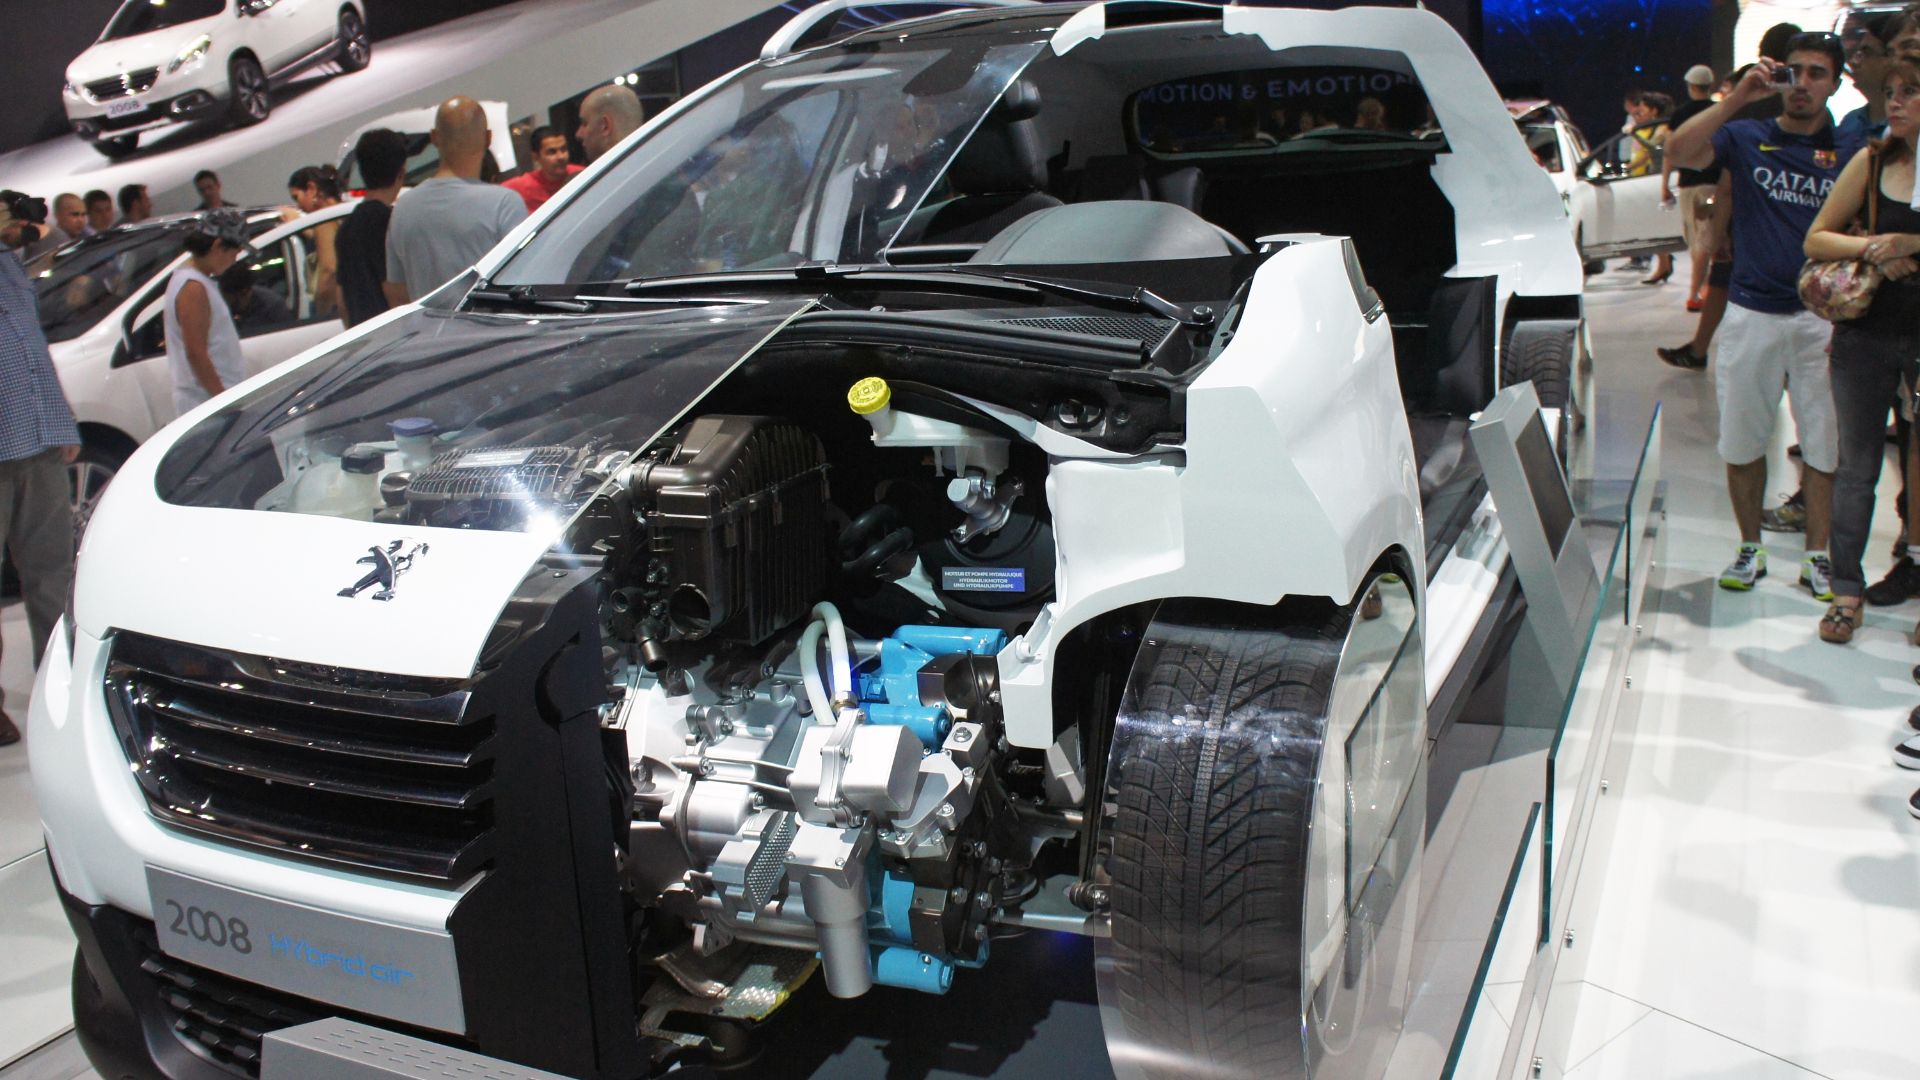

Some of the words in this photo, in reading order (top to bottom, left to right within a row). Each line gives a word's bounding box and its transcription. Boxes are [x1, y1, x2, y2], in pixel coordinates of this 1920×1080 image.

[1241, 84, 1257, 99] &
[1753, 166, 1835, 196] QATAR
[1768, 189, 1822, 208] AIRWAY
[166, 899, 252, 954] 2008
[369, 962, 416, 985] air
